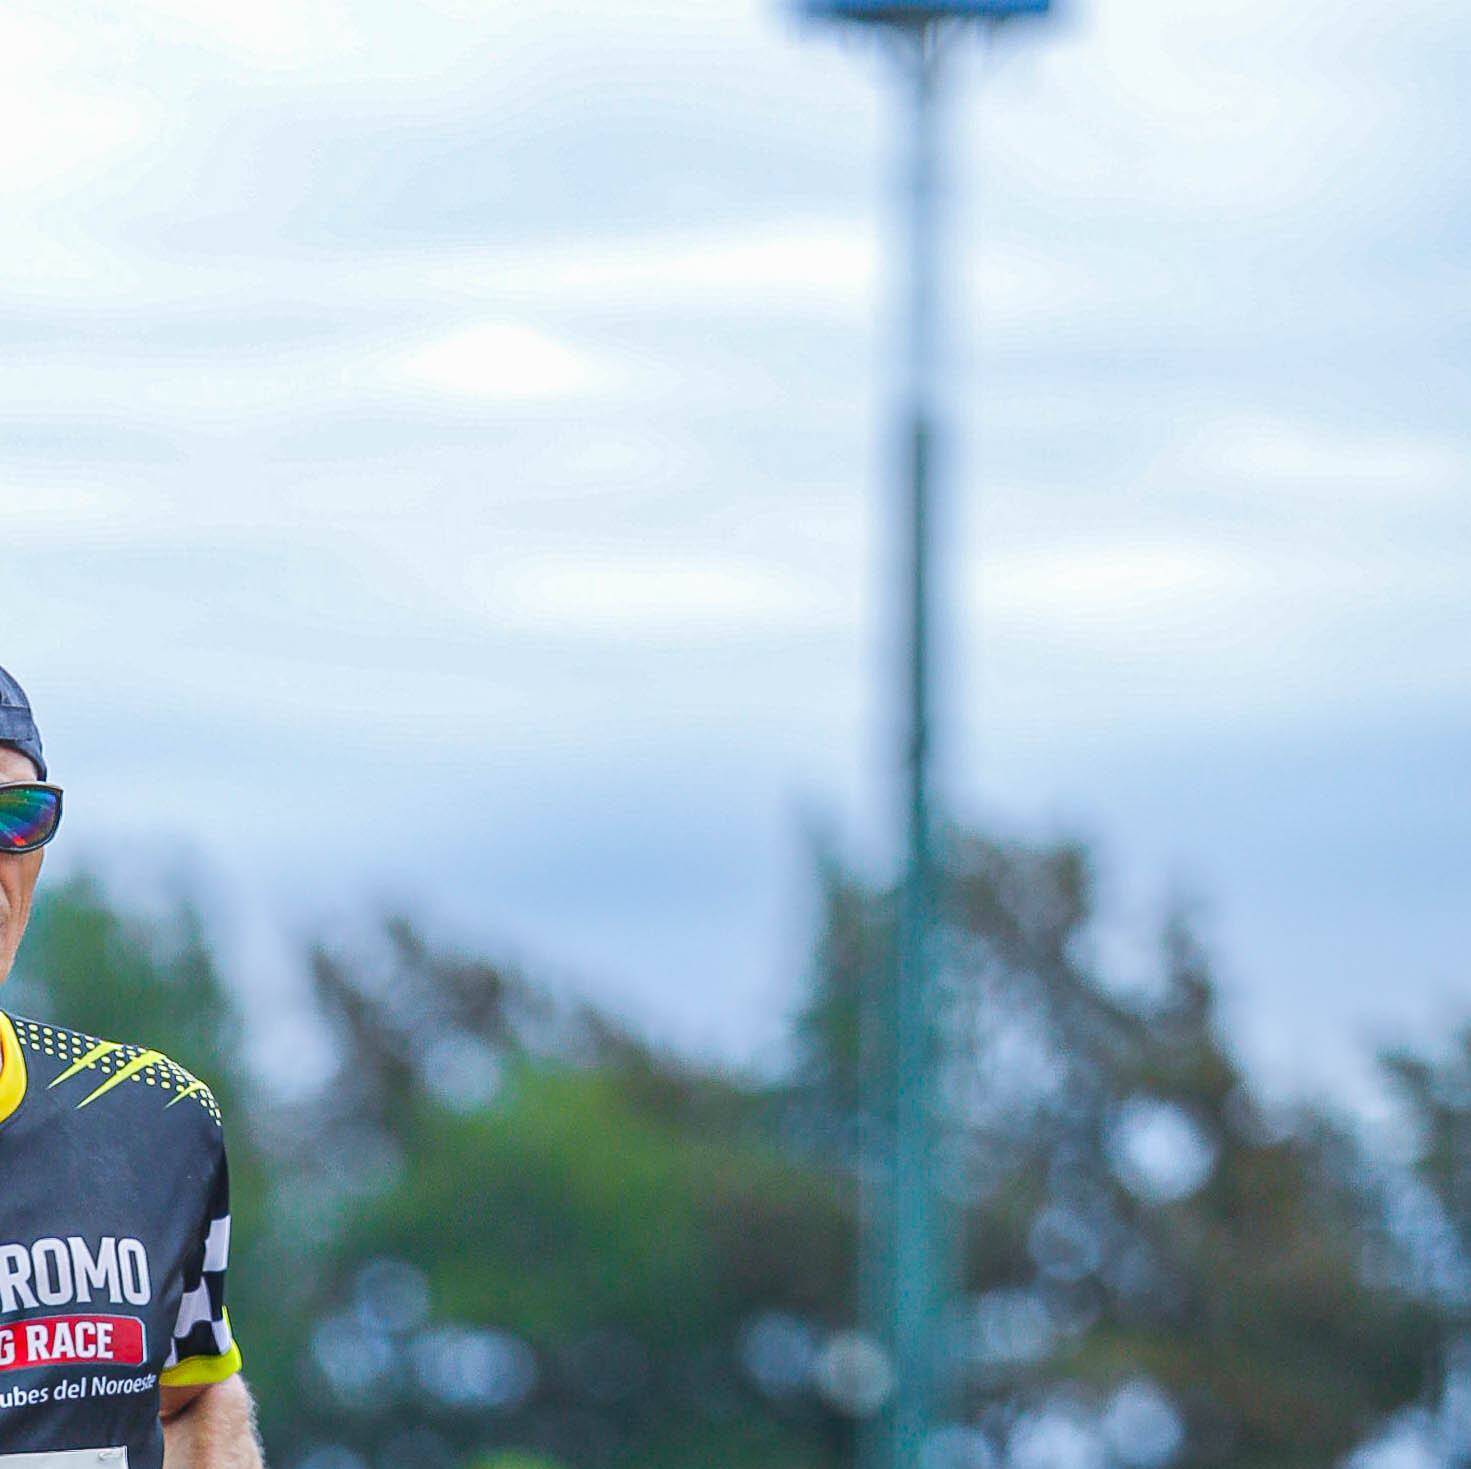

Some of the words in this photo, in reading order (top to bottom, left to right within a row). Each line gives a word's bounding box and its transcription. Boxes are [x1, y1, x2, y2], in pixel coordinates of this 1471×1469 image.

[25, 1322, 115, 1361] RACE
[53, 1377, 86, 1401] del
[91, 1373, 157, 1397] Noroeste
